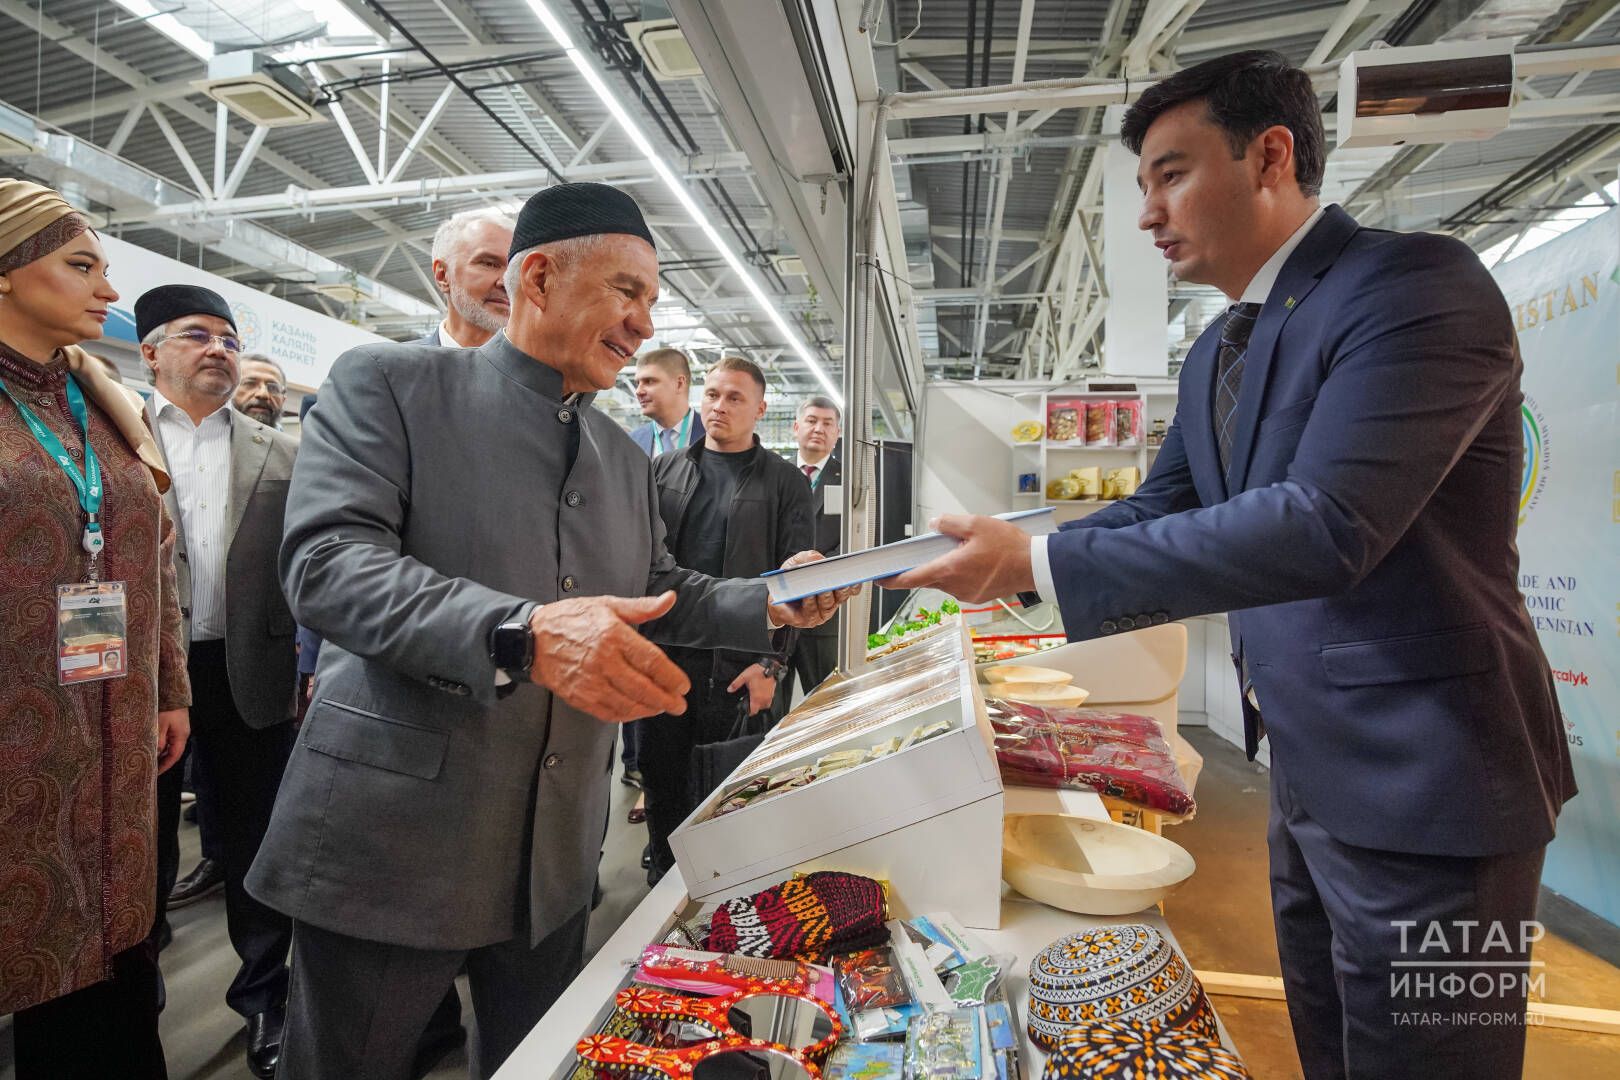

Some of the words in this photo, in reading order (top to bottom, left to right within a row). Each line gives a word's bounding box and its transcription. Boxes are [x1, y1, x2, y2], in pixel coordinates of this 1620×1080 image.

[272, 319, 318, 343] КАЗАНЬ
[272, 335, 317, 355] ХАЛЯЛЬ
[272, 346, 316, 366] МАРКЕТ
[1547, 576, 1576, 591] AND
[1531, 616, 1595, 637] ENISTAN
